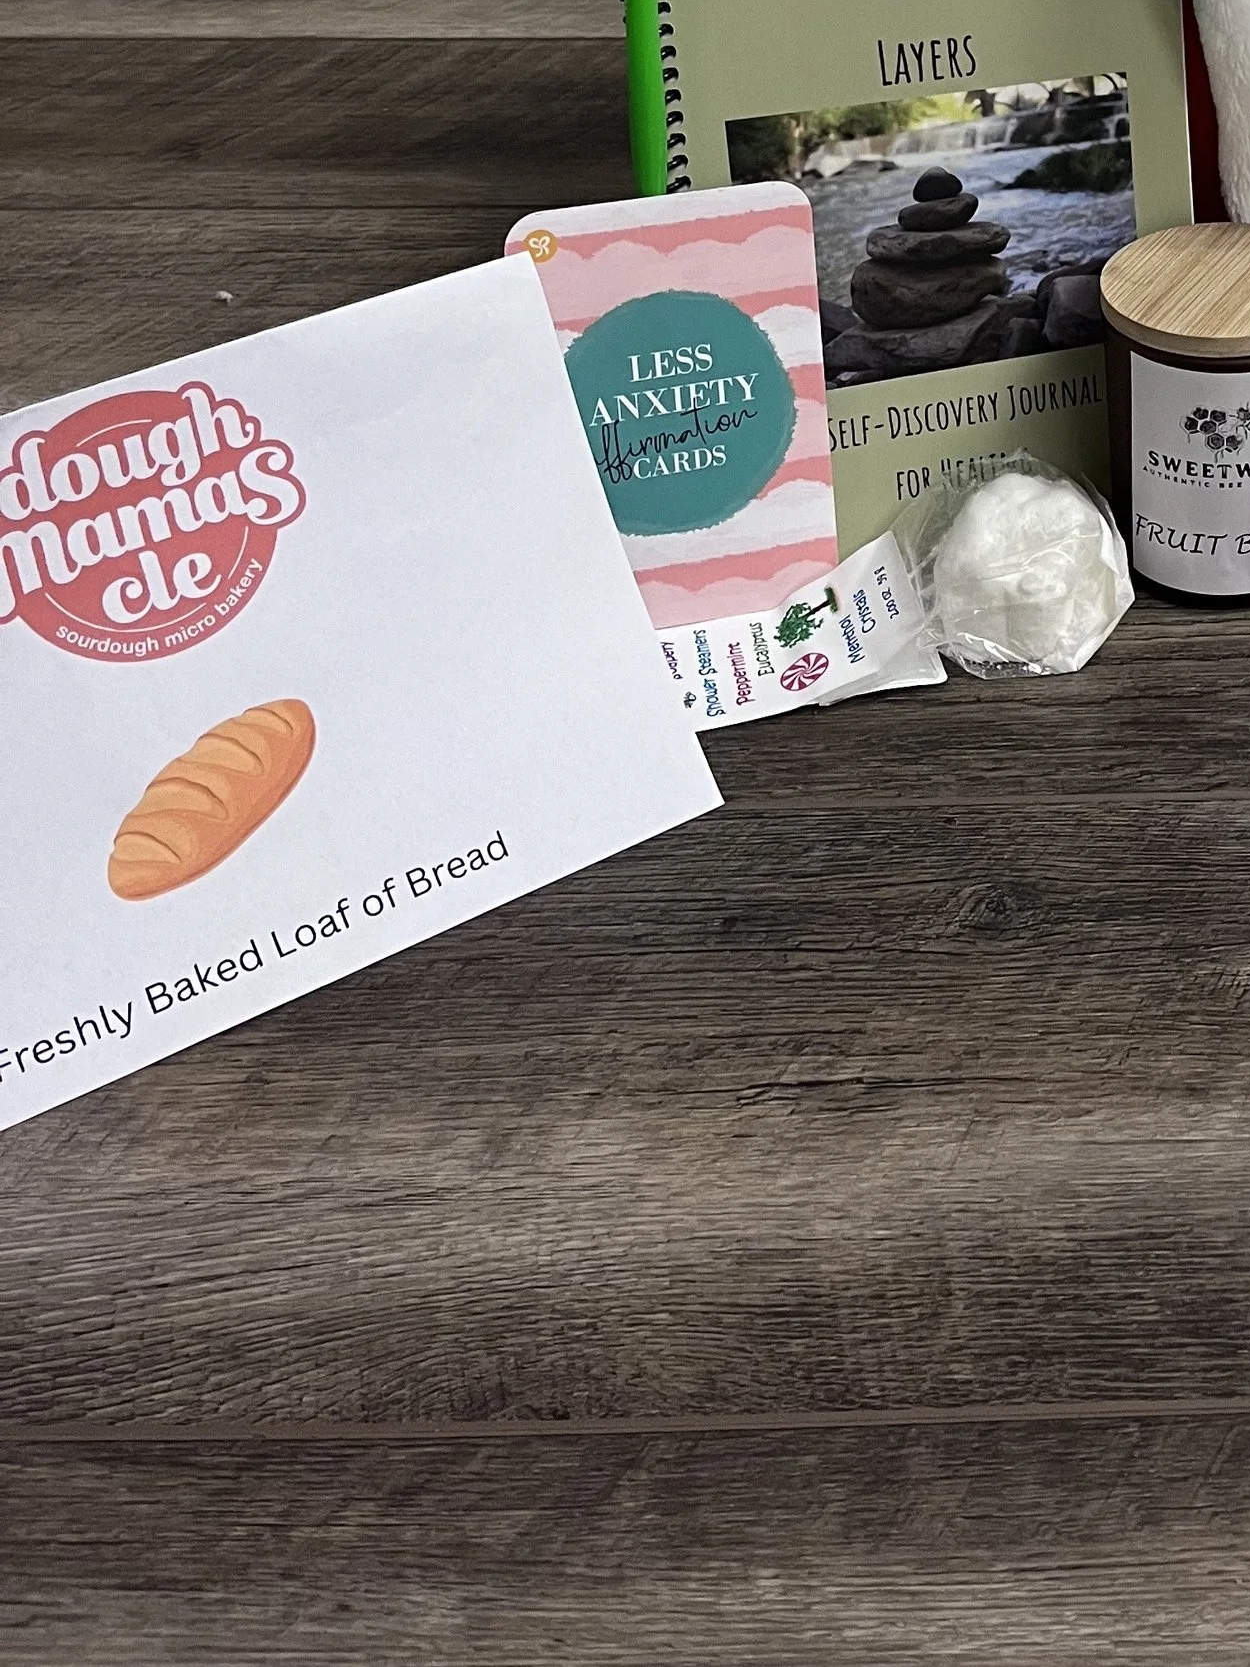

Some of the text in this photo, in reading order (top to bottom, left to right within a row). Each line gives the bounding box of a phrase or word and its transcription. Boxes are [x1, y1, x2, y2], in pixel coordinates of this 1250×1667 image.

[877, 35, 978, 87] LAYERS
[627, 343, 713, 383] LESS
[589, 373, 759, 427] ANXIETY
[1007, 374, 1103, 421] JOURNAL
[0, 387, 255, 521] dough
[594, 397, 758, 484] ffirmation
[633, 444, 727, 480] CARDS
[896, 466, 931, 501] FOR
[1143, 465, 1210, 489] AUTHENTIC
[1219, 481, 1243, 489] BEE
[1135, 512, 1229, 556] FRUIT
[56, 557, 264, 658] sourdough micro bakery
[102, 550, 223, 624] cle
[852, 589, 877, 634] Crystals
[749, 622, 776, 677] Eucalyptus
[838, 614, 866, 664] Menthol
[693, 629, 727, 717] Shower Steamers
[727, 641, 756, 706] Peppermint
[145, 939, 263, 1015] Baked
[271, 898, 353, 959] Loaf
[362, 877, 397, 917] of
[405, 830, 510, 898] Bread
